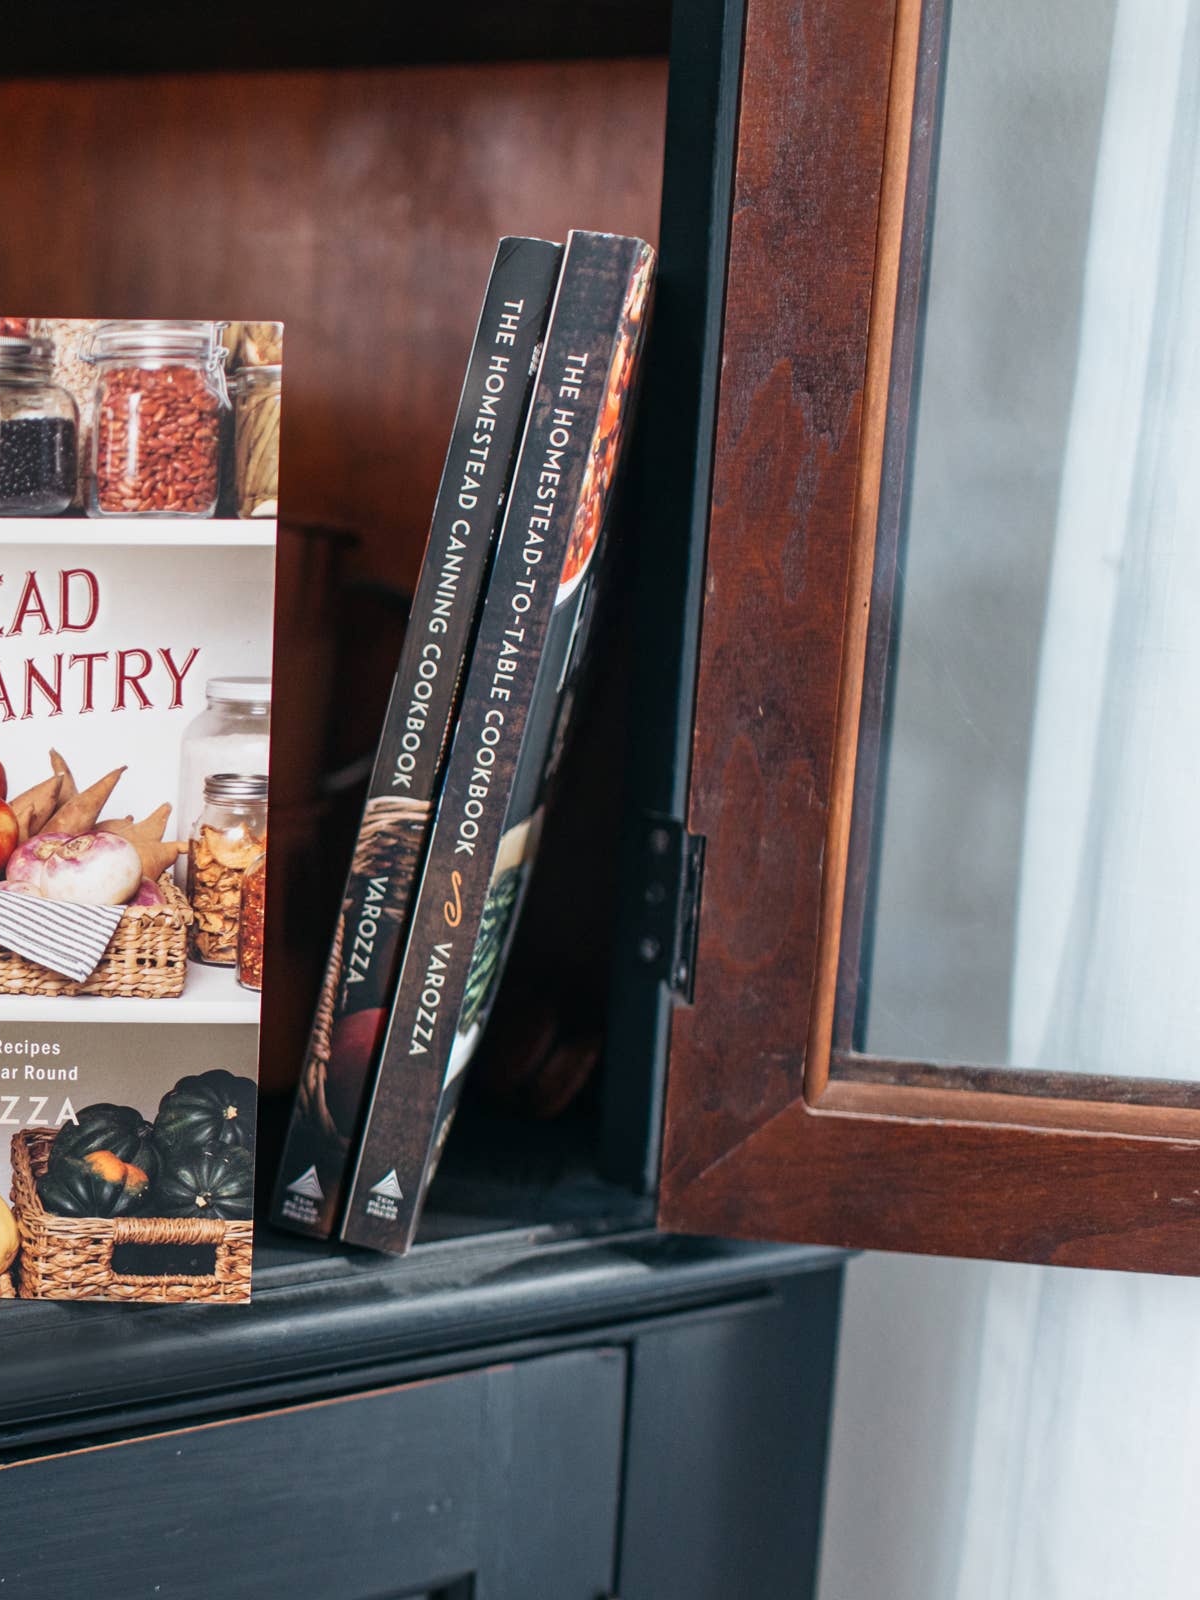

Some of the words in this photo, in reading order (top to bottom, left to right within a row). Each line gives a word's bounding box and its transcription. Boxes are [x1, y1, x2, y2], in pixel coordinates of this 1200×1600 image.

[495, 299, 525, 347] THE
[559, 353, 589, 401] THE
[456, 355, 510, 511] HOMESTEAD
[428, 519, 472, 634] CANNING
[490, 408, 576, 702] HOMESTEAD-TO-TABLE
[392, 643, 442, 789] COOKBOOK
[454, 709, 505, 857] COOKBOOK
[346, 876, 389, 985] VAROZZA
[408, 942, 453, 1057] VAROZZA
[24, 1065, 79, 1082] Round
